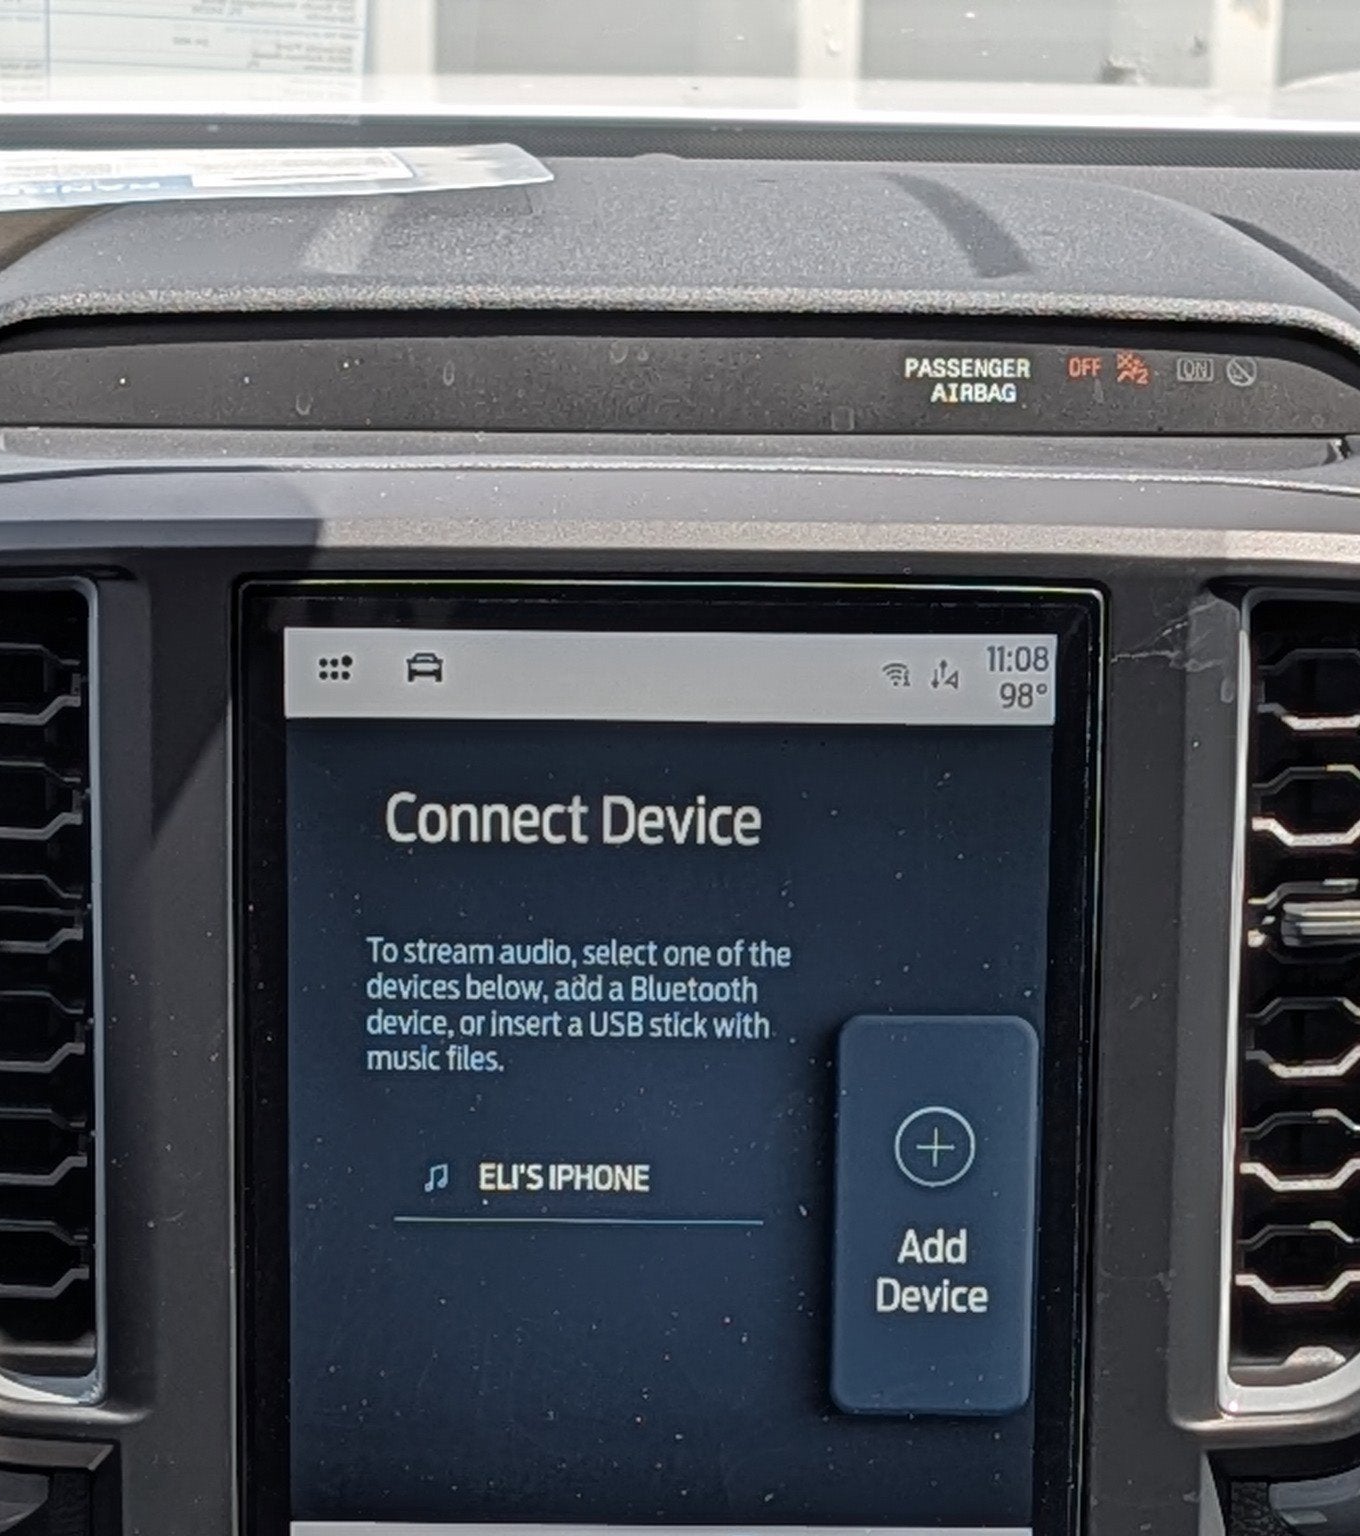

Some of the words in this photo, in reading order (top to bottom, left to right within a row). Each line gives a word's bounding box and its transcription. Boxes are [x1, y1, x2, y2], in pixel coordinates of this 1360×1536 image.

[904, 357, 1031, 378] PASSENGER
[1068, 356, 1102, 378] OFF
[1183, 360, 1207, 379] ON
[930, 382, 1017, 403] AIRBAG
[986, 645, 1050, 673] 11:08
[386, 791, 589, 845] Connect
[602, 795, 762, 846] Device
[365, 936, 399, 963] To
[403, 938, 494, 965] stream
[498, 937, 578, 969] audio,
[582, 938, 658, 967] select
[663, 945, 712, 967] one
[716, 938, 745, 967] of
[748, 939, 792, 968] the
[366, 971, 461, 1000] devices
[465, 972, 549, 1004] below,
[554, 973, 603, 1002] add
[608, 980, 625, 1002] a
[630, 974, 758, 1004] Bluetooth
[366, 1007, 455, 1039] device,
[459, 1015, 486, 1037] or
[490, 1009, 563, 1037] insert
[567, 1016, 584, 1037] a
[589, 1010, 644, 1038] USB
[649, 1011, 708, 1039] stick
[712, 1011, 770, 1039] with
[366, 1044, 441, 1071] music
[445, 1044, 505, 1072] files.
[479, 1162, 544, 1191] ELI'S
[548, 1163, 650, 1192] IPHONE
[897, 1228, 967, 1264] Add
[876, 1276, 989, 1313] Device
